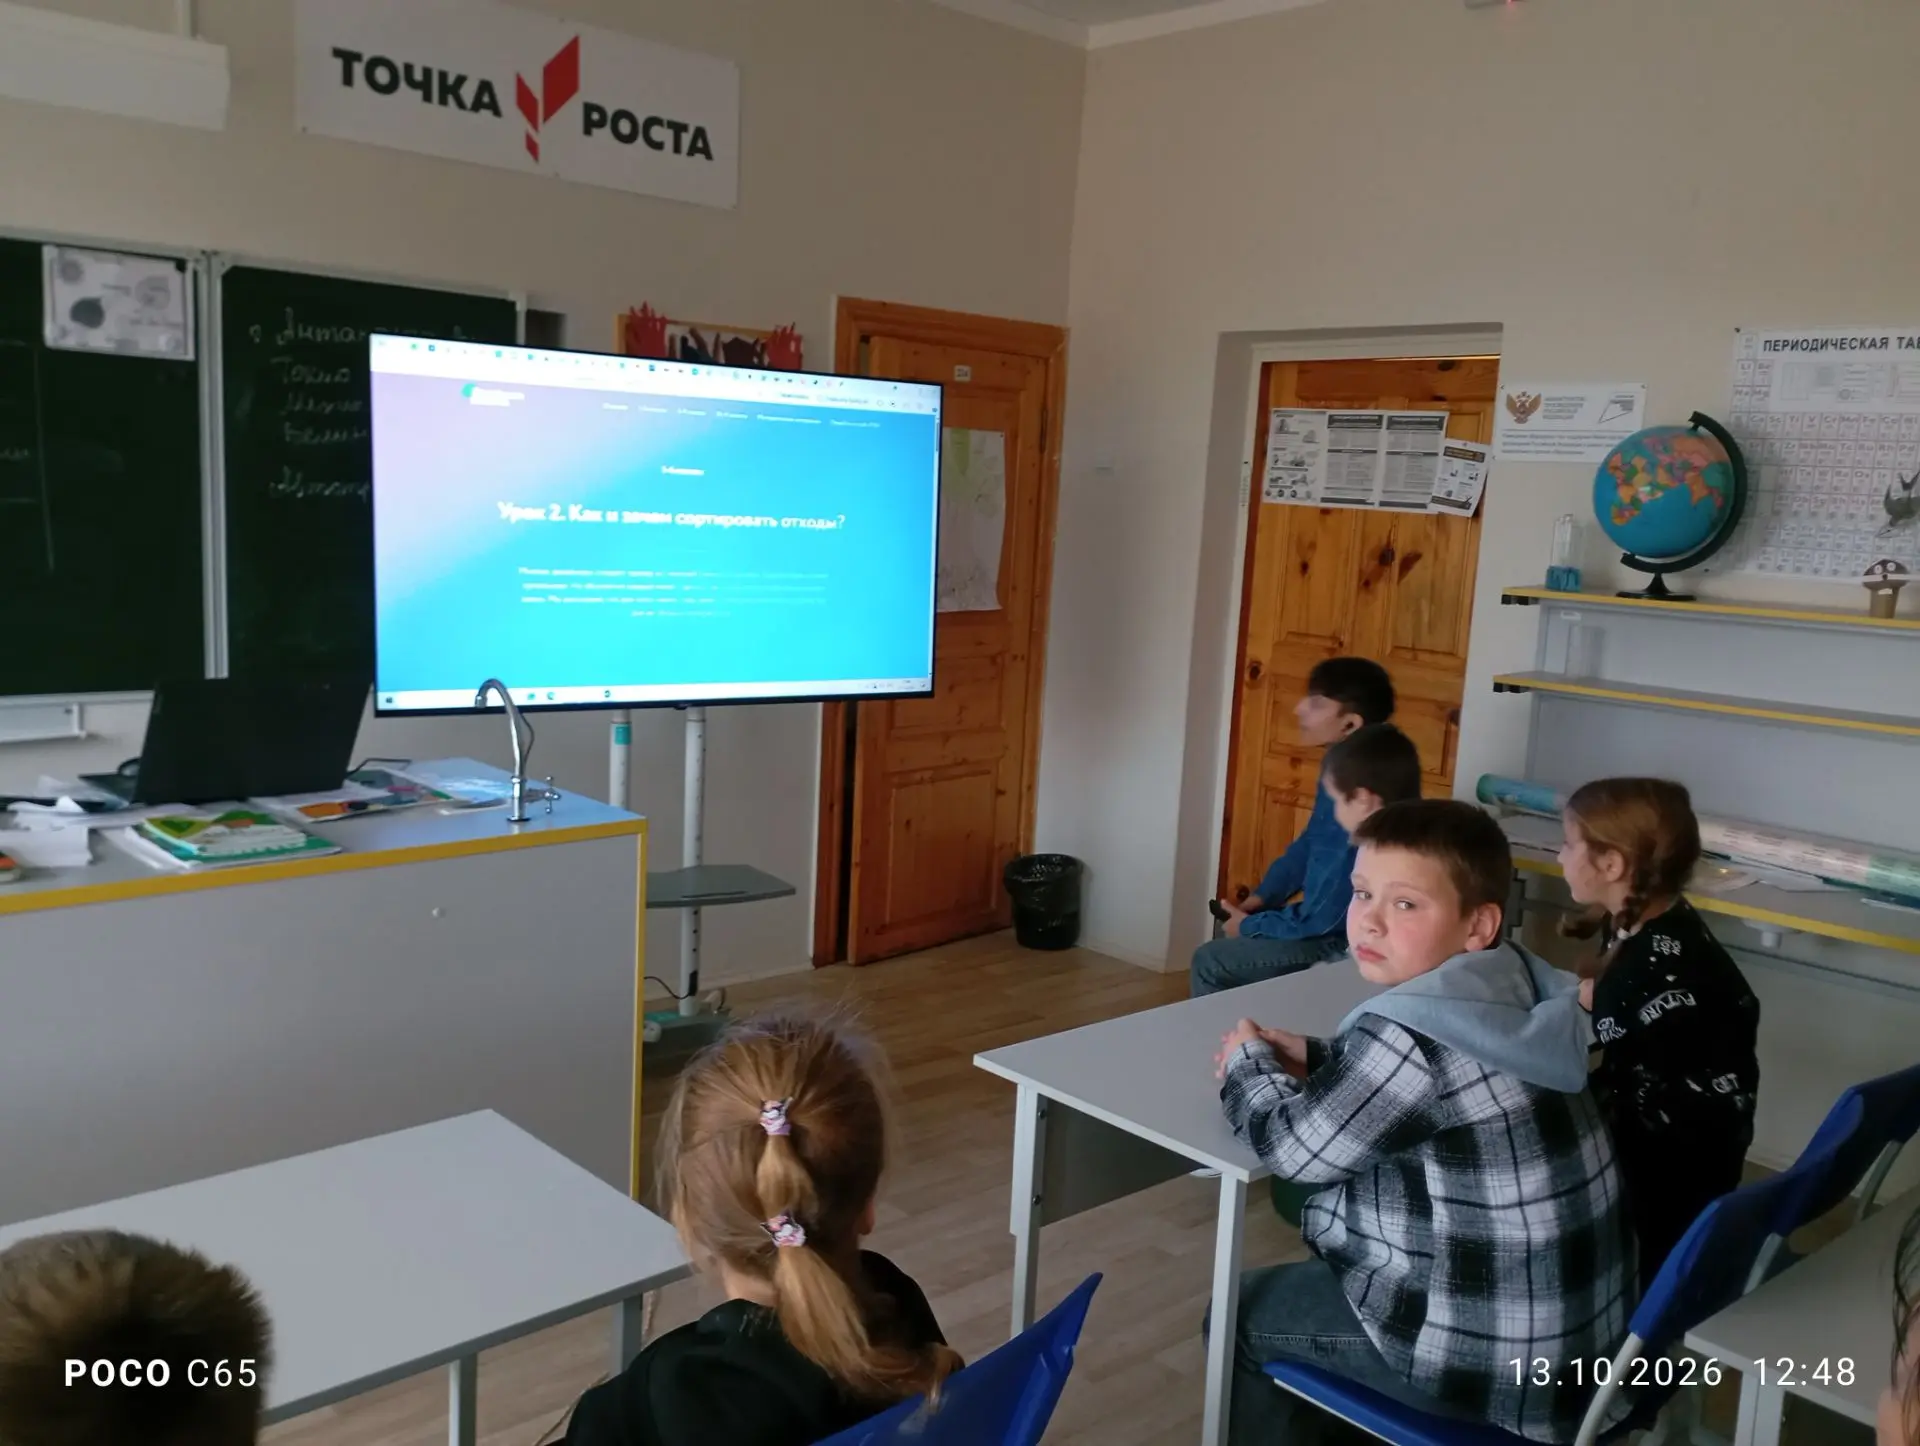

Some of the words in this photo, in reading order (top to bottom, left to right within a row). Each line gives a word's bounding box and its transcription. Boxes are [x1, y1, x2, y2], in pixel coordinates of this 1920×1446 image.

[331, 46, 503, 119] ТОЧКА
[582, 102, 714, 161] РОСТА
[1763, 336, 1890, 352] ПЕРИОДИЧЕСКАЯ
[675, 512, 777, 529] сортировать
